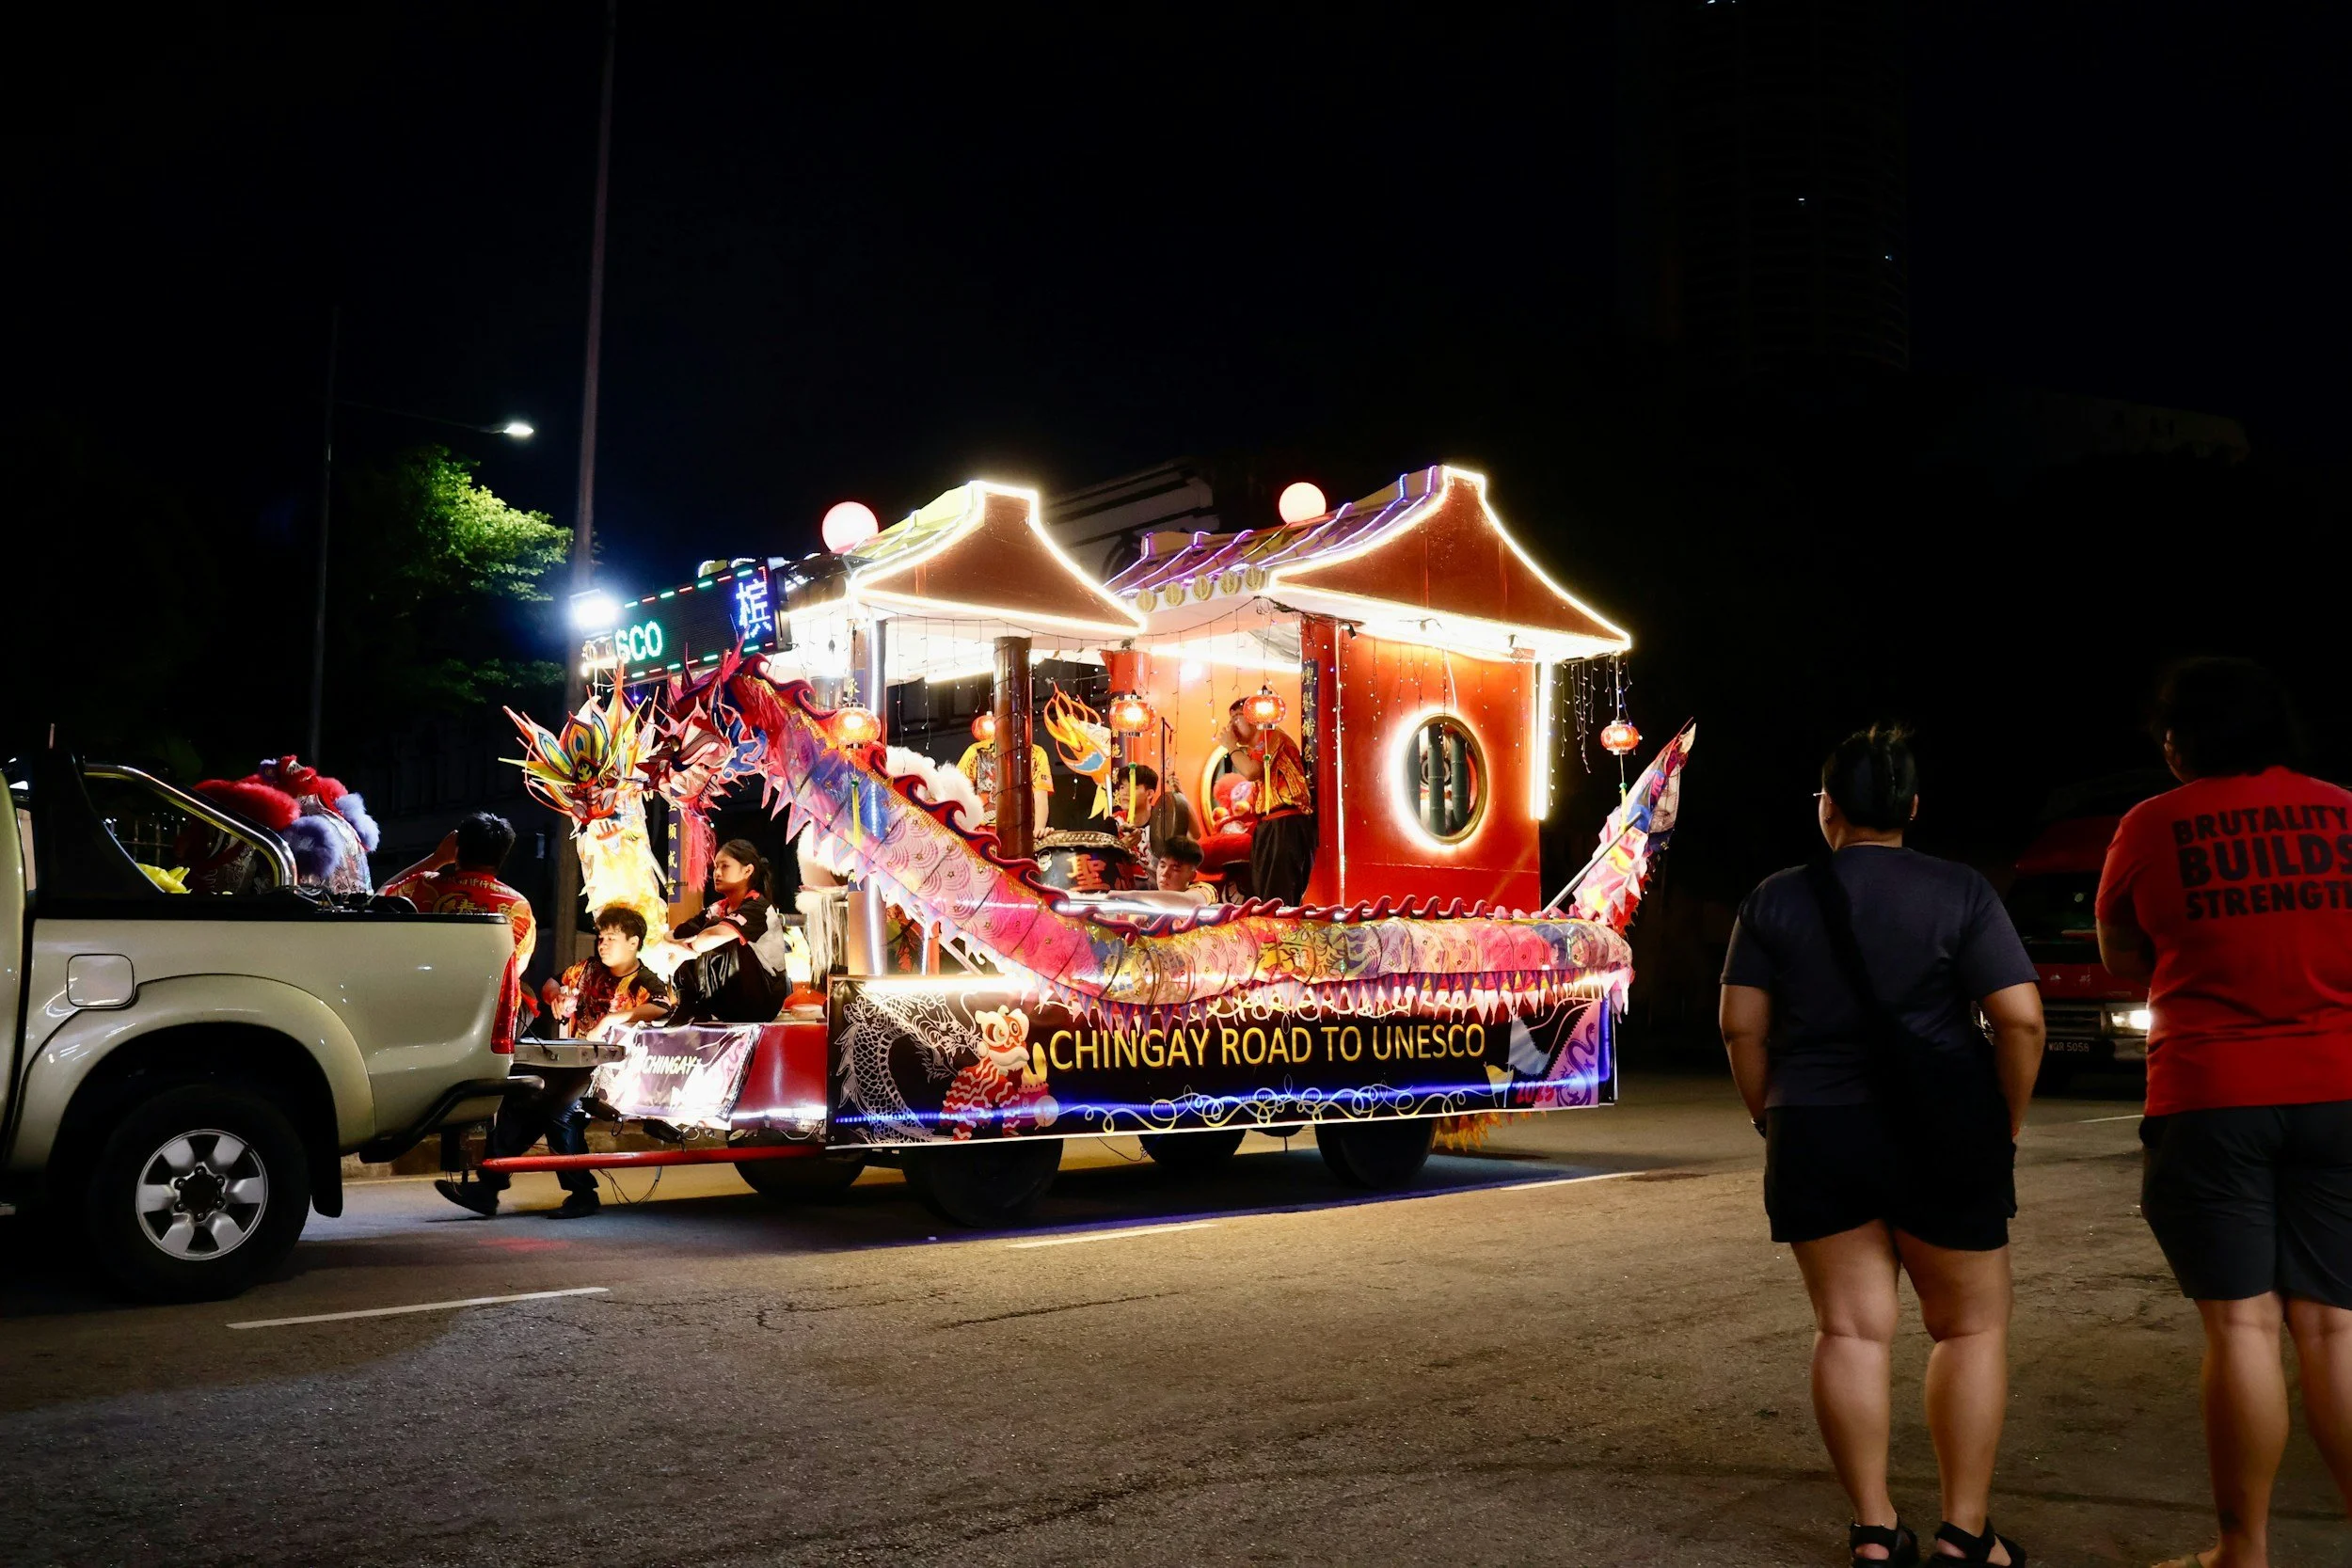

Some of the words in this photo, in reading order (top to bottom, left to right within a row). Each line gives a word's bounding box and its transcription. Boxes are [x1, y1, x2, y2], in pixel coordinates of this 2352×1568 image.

[2172, 805, 2347, 845] BRUTALITY
[2178, 833, 2352, 888] BUILDS
[642, 1054, 698, 1075] CHINGAY
[1049, 1029, 1210, 1070] CHINGAY
[1221, 1027, 1312, 1066] ROAD
[1320, 1026, 1362, 1062] TO
[1373, 1023, 1486, 1061] UNESCO
